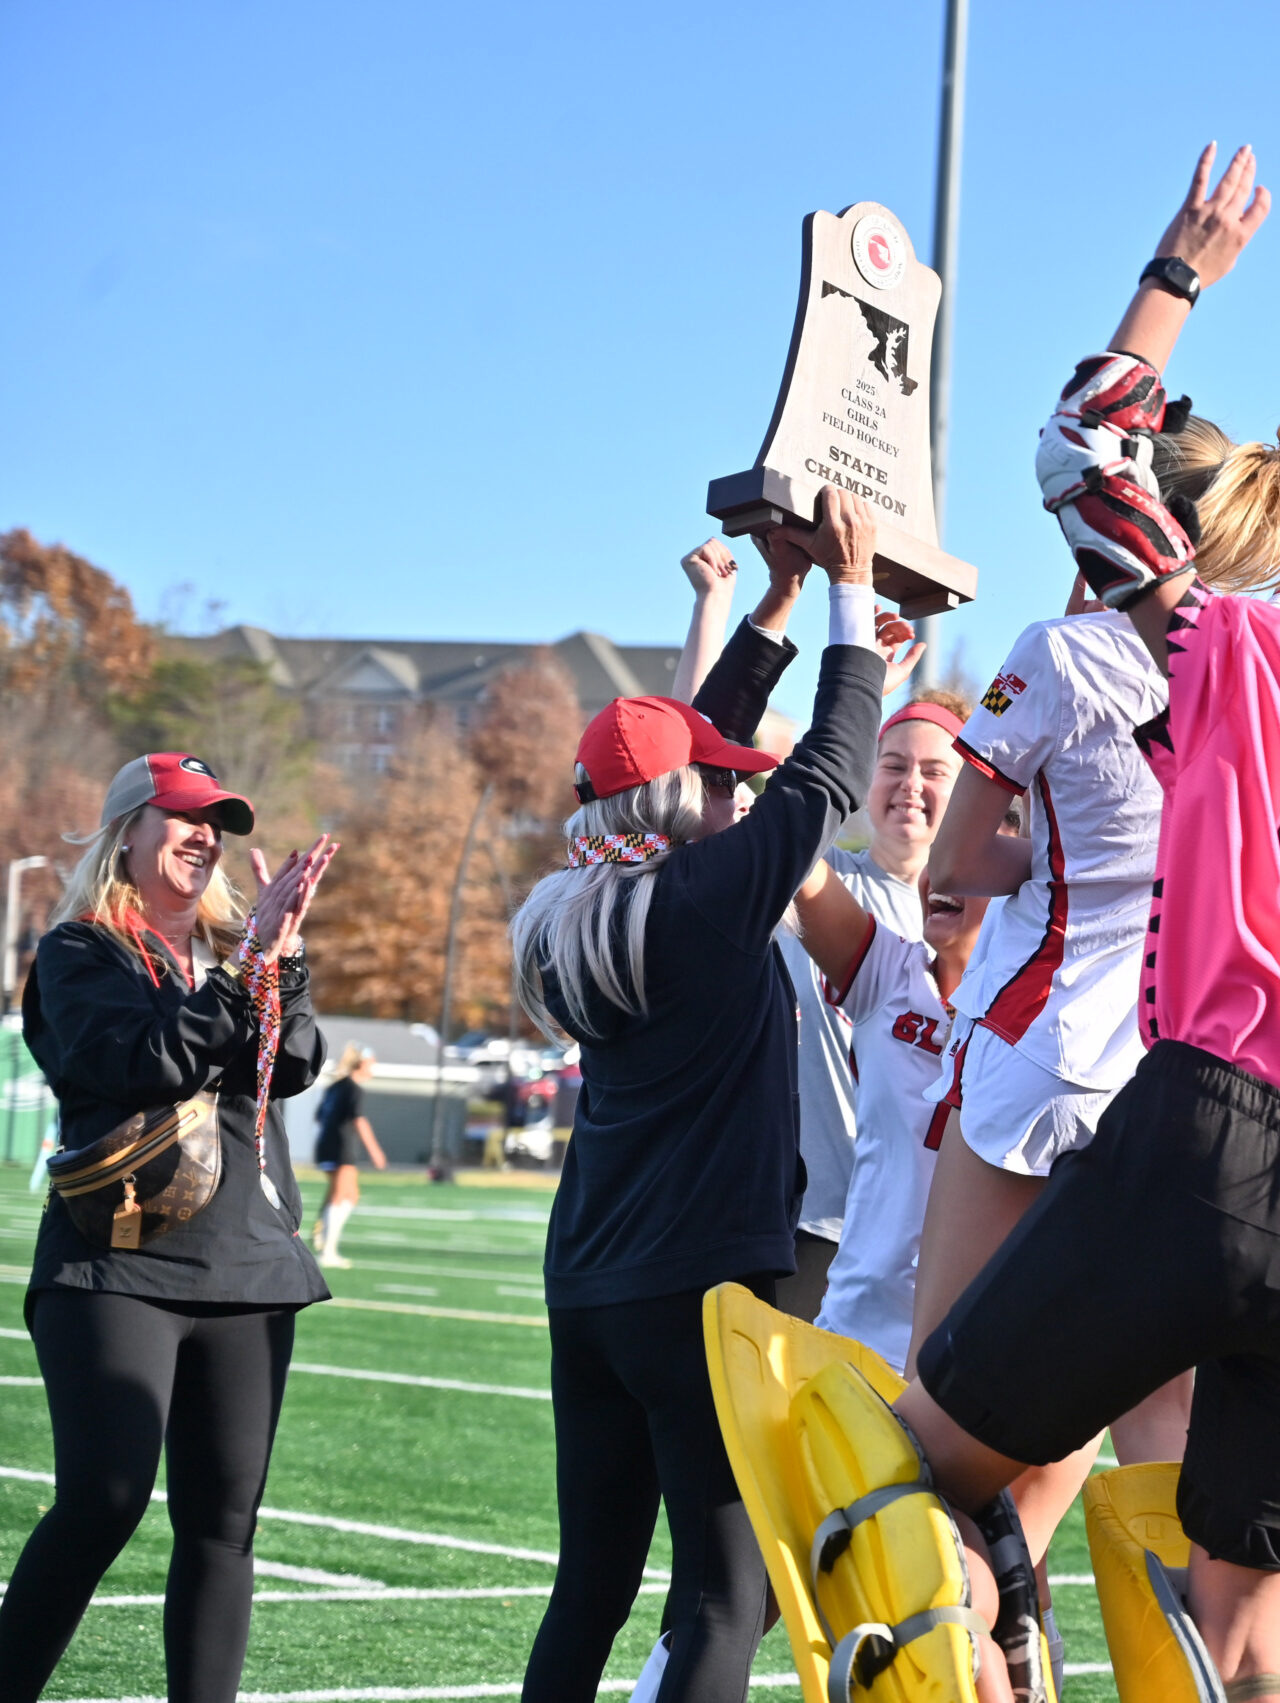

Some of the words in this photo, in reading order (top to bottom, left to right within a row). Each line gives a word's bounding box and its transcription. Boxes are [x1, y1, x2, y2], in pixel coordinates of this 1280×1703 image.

[841, 388, 873, 412] CLASS
[875, 405, 887, 419] 2A
[856, 378, 876, 396] 2025
[822, 412, 854, 436] FIELD
[856, 429, 900, 458] HOCKEY
[847, 408, 879, 431] GIRLS
[828, 445, 888, 485] STATE
[804, 458, 907, 517] CHAMPION
